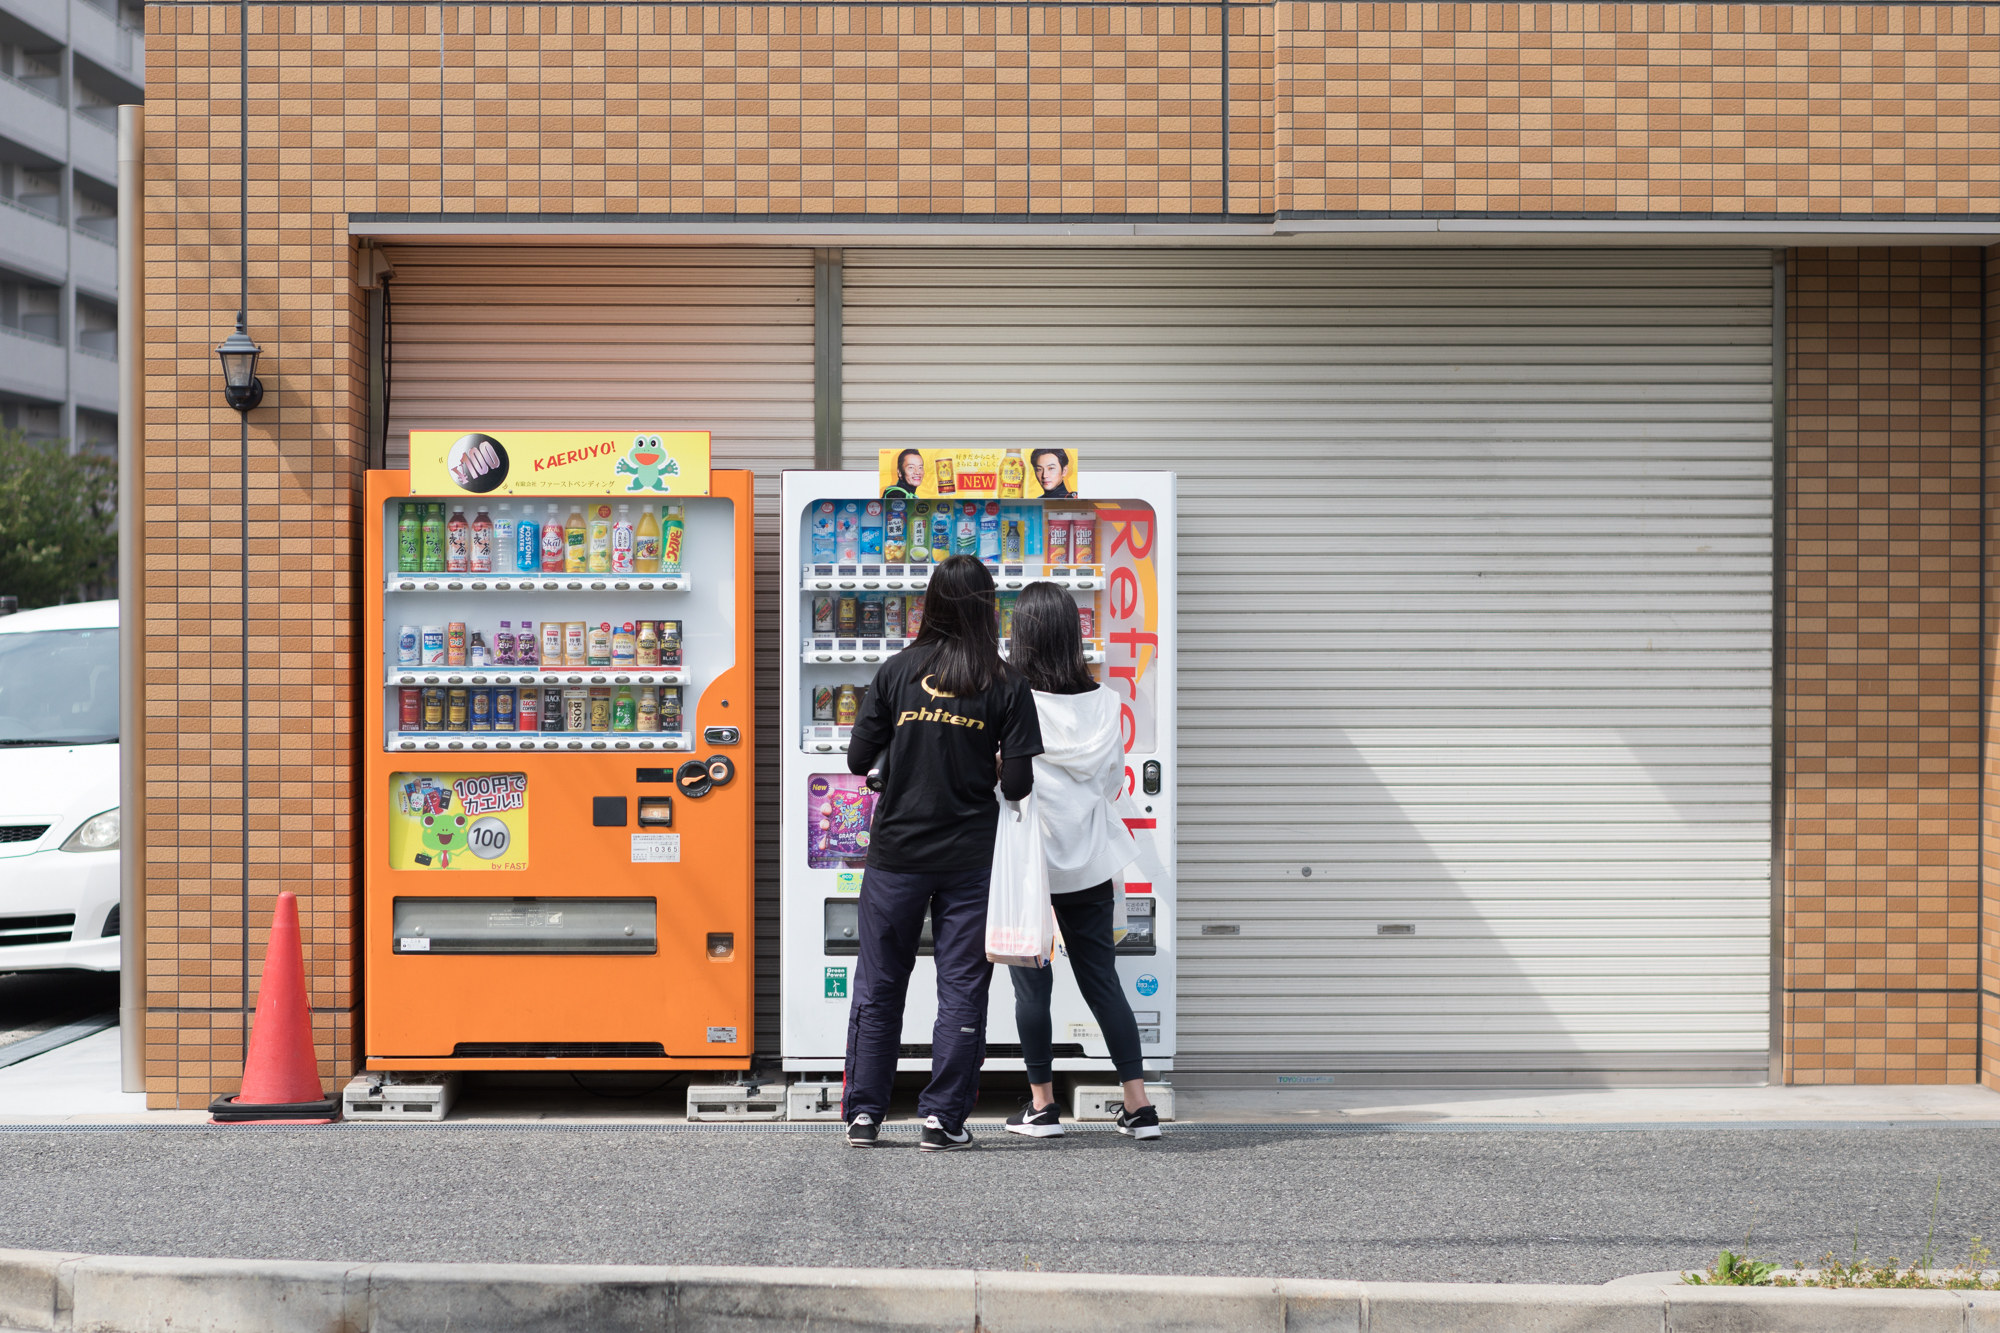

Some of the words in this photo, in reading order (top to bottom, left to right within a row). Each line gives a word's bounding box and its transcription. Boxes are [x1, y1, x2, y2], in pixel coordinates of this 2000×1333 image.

[450, 440, 501, 485] ¥100
[533, 441, 617, 472] KAERUYO!
[539, 479, 616, 489] ファーストベンディング
[963, 475, 995, 488] NEW
[1051, 529, 1066, 537] chip
[1076, 529, 1092, 537] chip
[1050, 537, 1066, 545] star
[1076, 537, 1092, 545] star
[574, 702, 582, 729] BOSS
[896, 707, 985, 730] phiten
[454, 776, 526, 798] 100円で
[473, 827, 506, 849] 100
[491, 862, 502, 870] by
[504, 862, 527, 870] FAST
